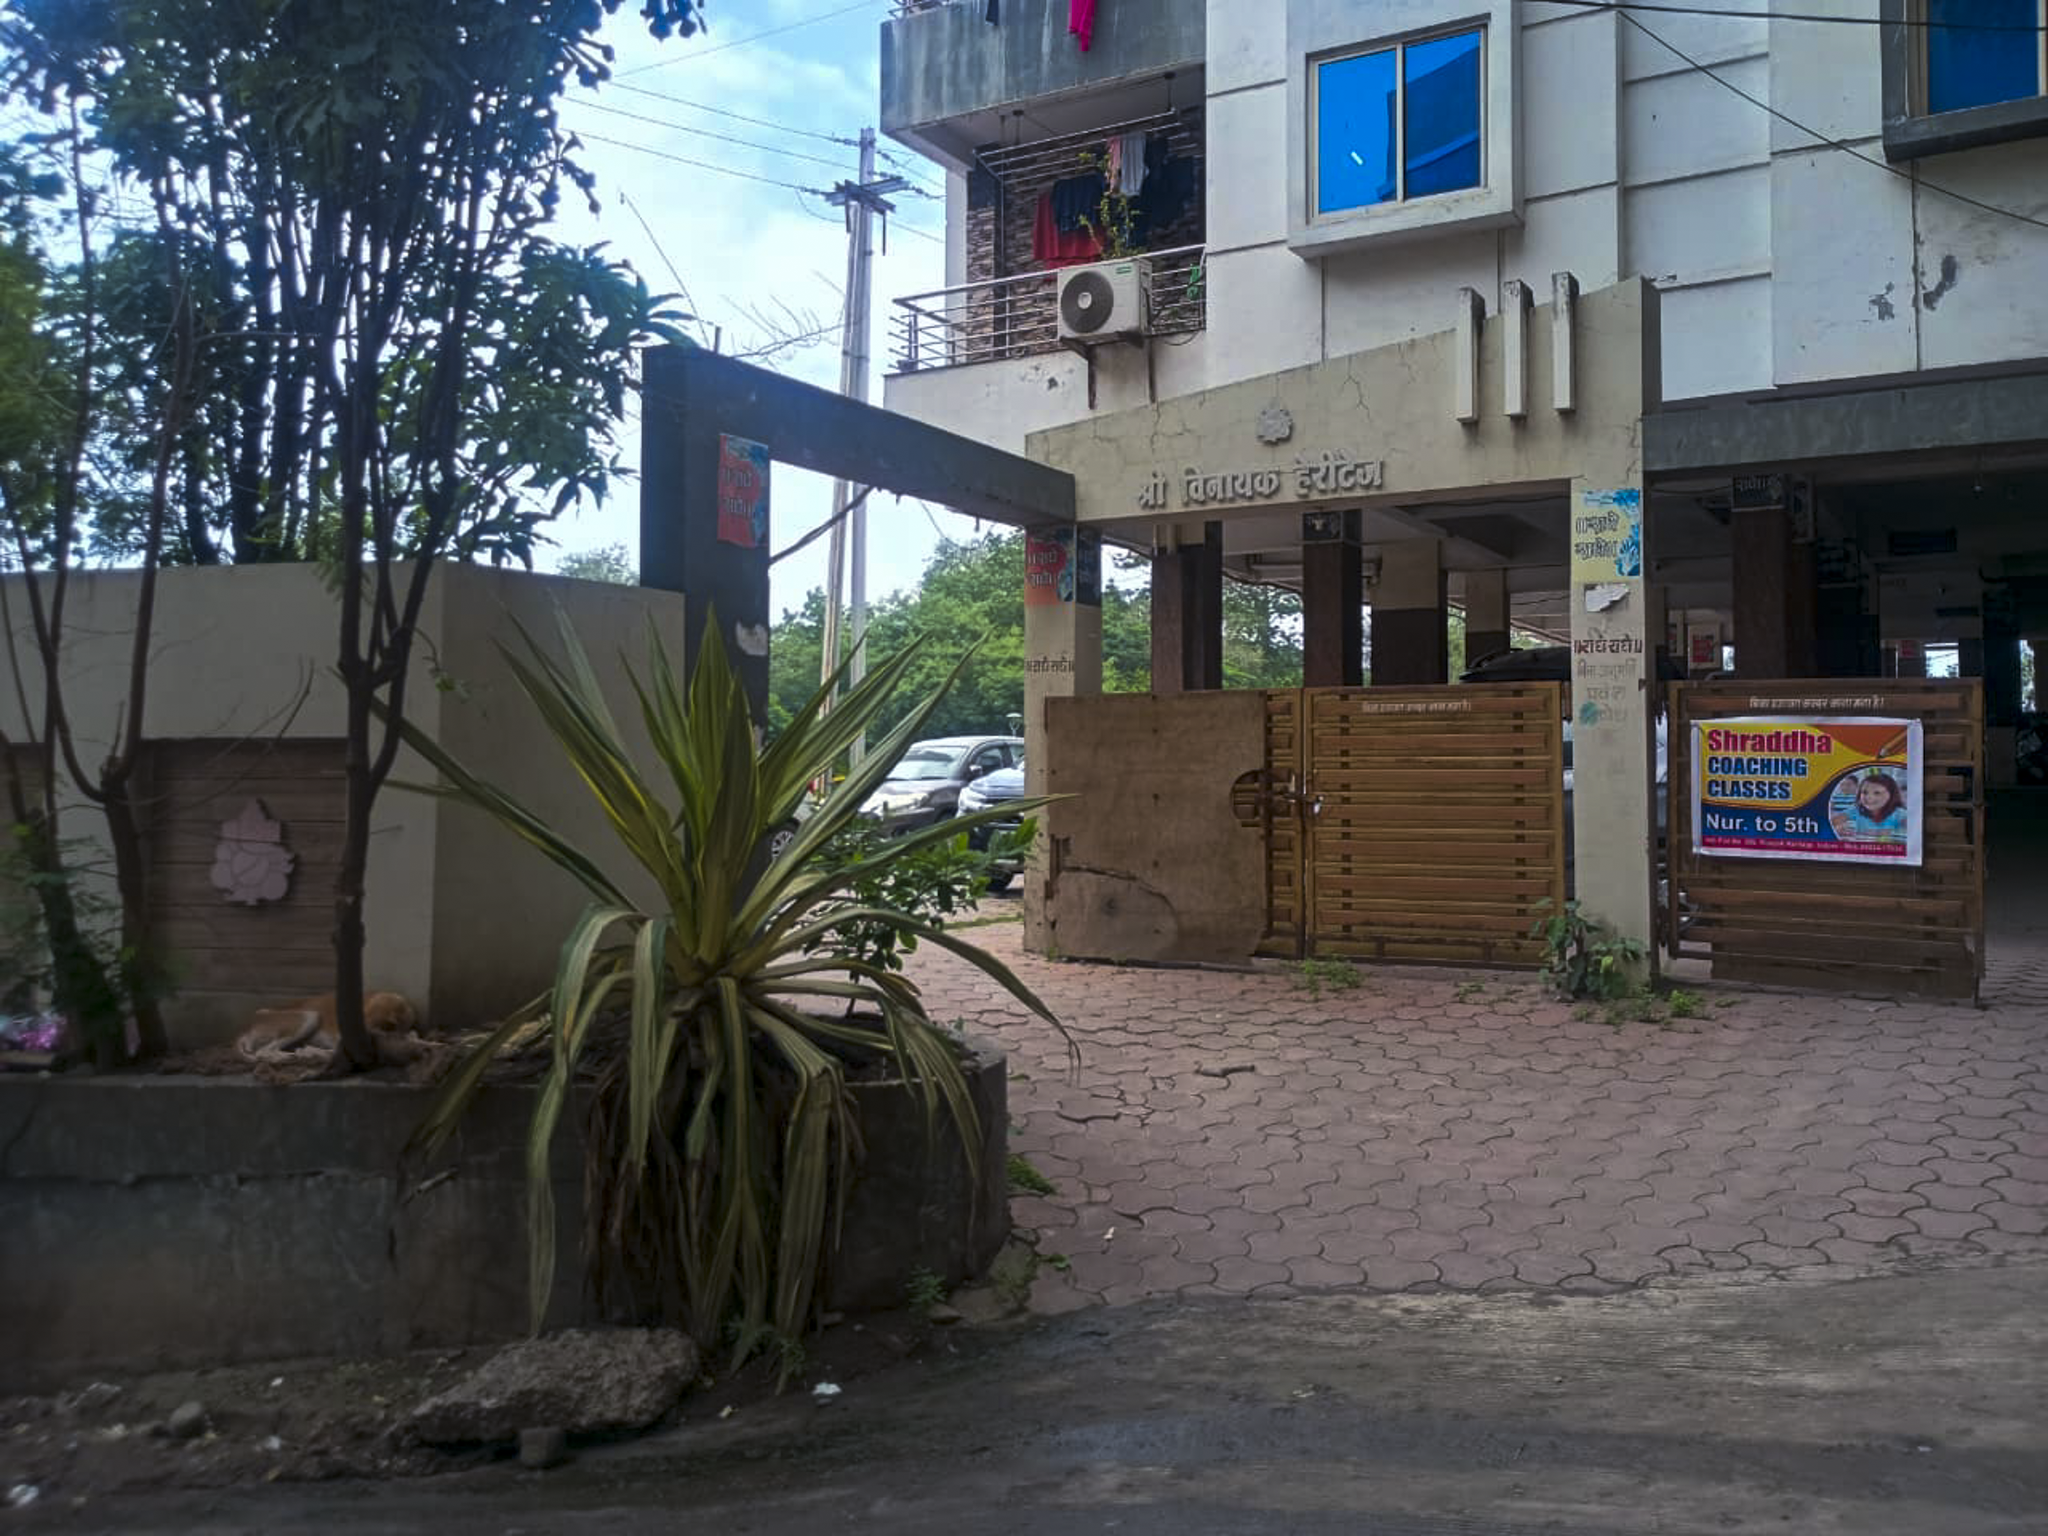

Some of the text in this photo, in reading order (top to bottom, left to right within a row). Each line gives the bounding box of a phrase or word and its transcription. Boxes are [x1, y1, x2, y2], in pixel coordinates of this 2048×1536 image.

[1138, 472, 1167, 508] श्री
[1184, 467, 1280, 505] विनायक
[1708, 729, 1832, 754] Shraddha
[1707, 756, 1808, 777] COACHING
[1707, 779, 1792, 800] CLASSES
[1706, 813, 1820, 834] Nur. to 5th
